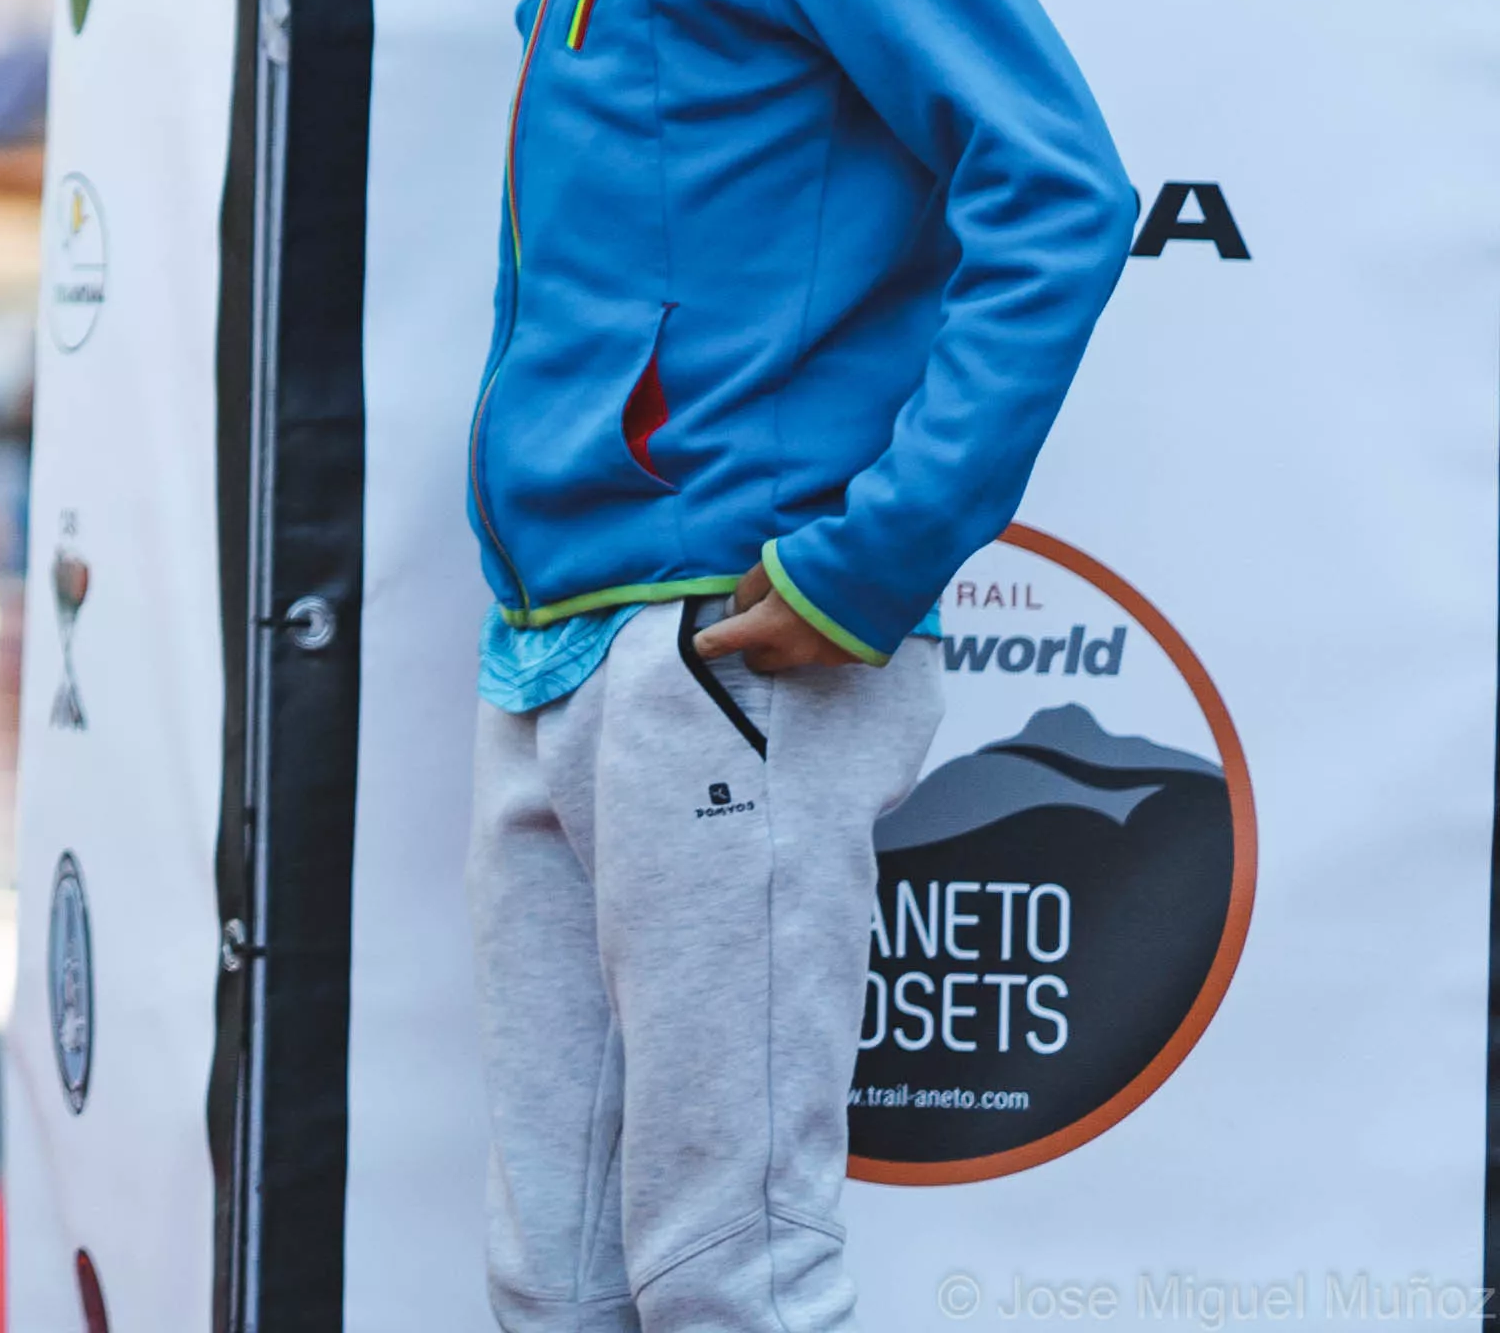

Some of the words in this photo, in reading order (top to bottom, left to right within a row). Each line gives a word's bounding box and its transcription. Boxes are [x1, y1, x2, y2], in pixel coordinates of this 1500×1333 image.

[938, 581, 1044, 610] RAIL
[942, 624, 1128, 677] world
[869, 880, 1071, 964] ANETO
[856, 972, 1070, 1056] OSETS
[846, 1084, 1030, 1112] w.trail-aneto.com
